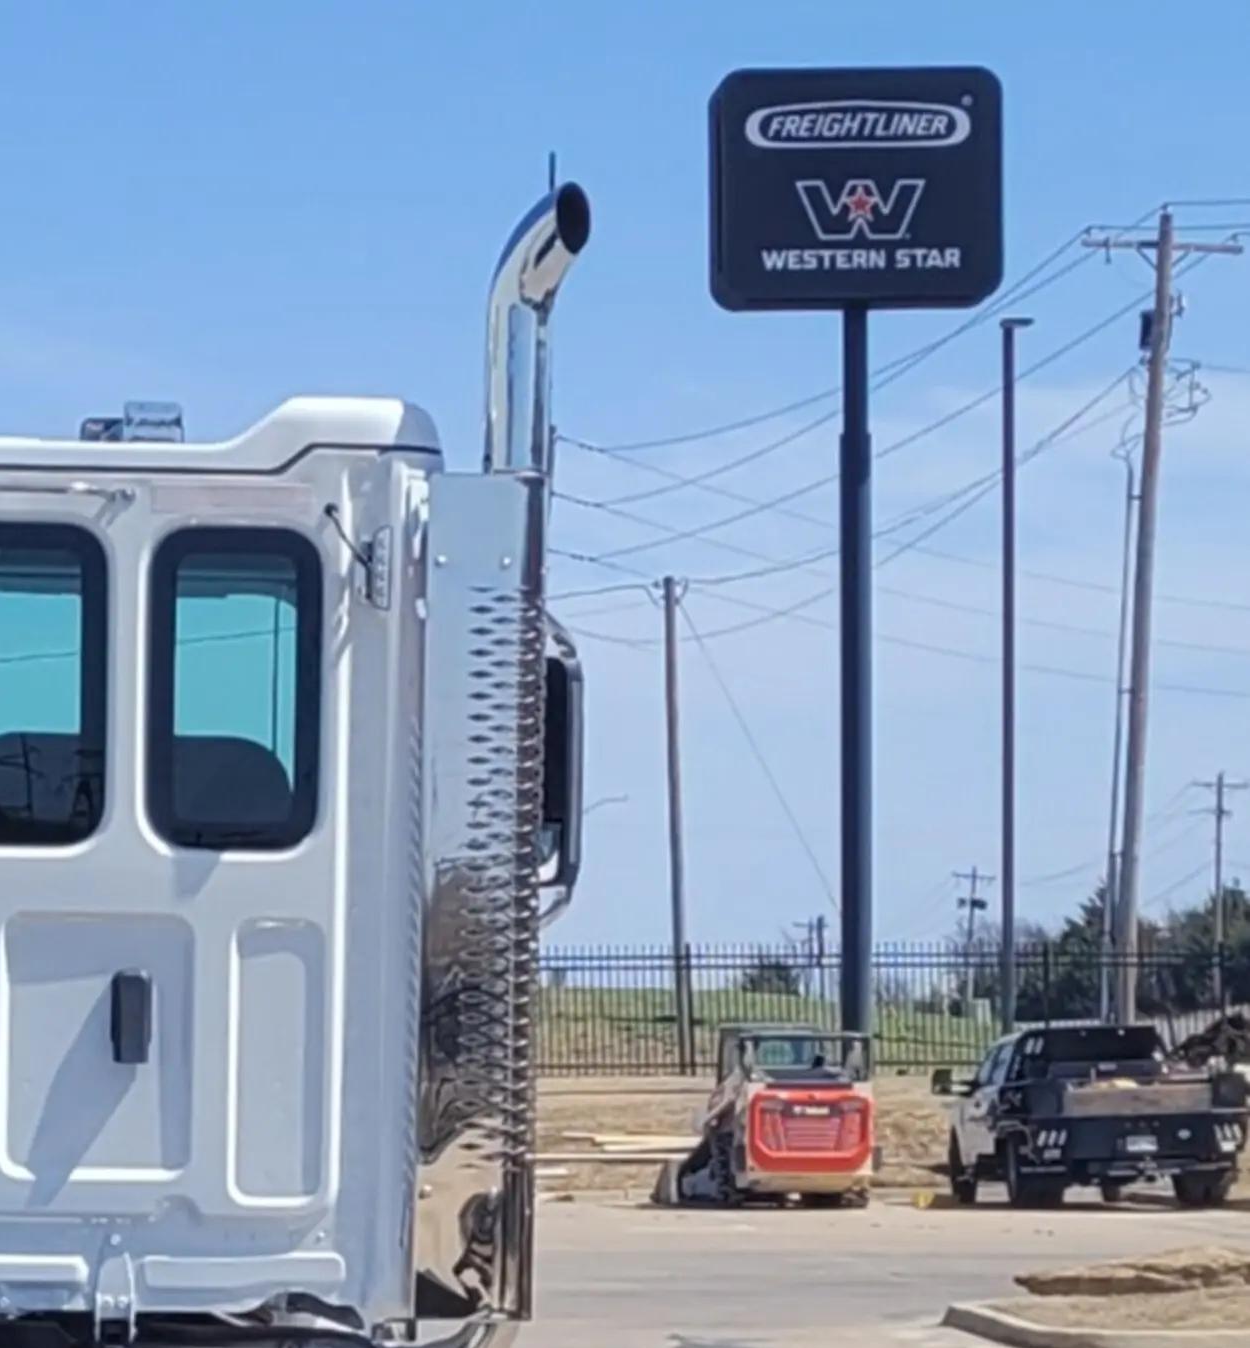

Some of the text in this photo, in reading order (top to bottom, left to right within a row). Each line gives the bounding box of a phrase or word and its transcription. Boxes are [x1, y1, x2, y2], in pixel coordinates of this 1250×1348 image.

[767, 111, 949, 138] FREIGHTLINER
[761, 247, 962, 271] WESTERN STAR
